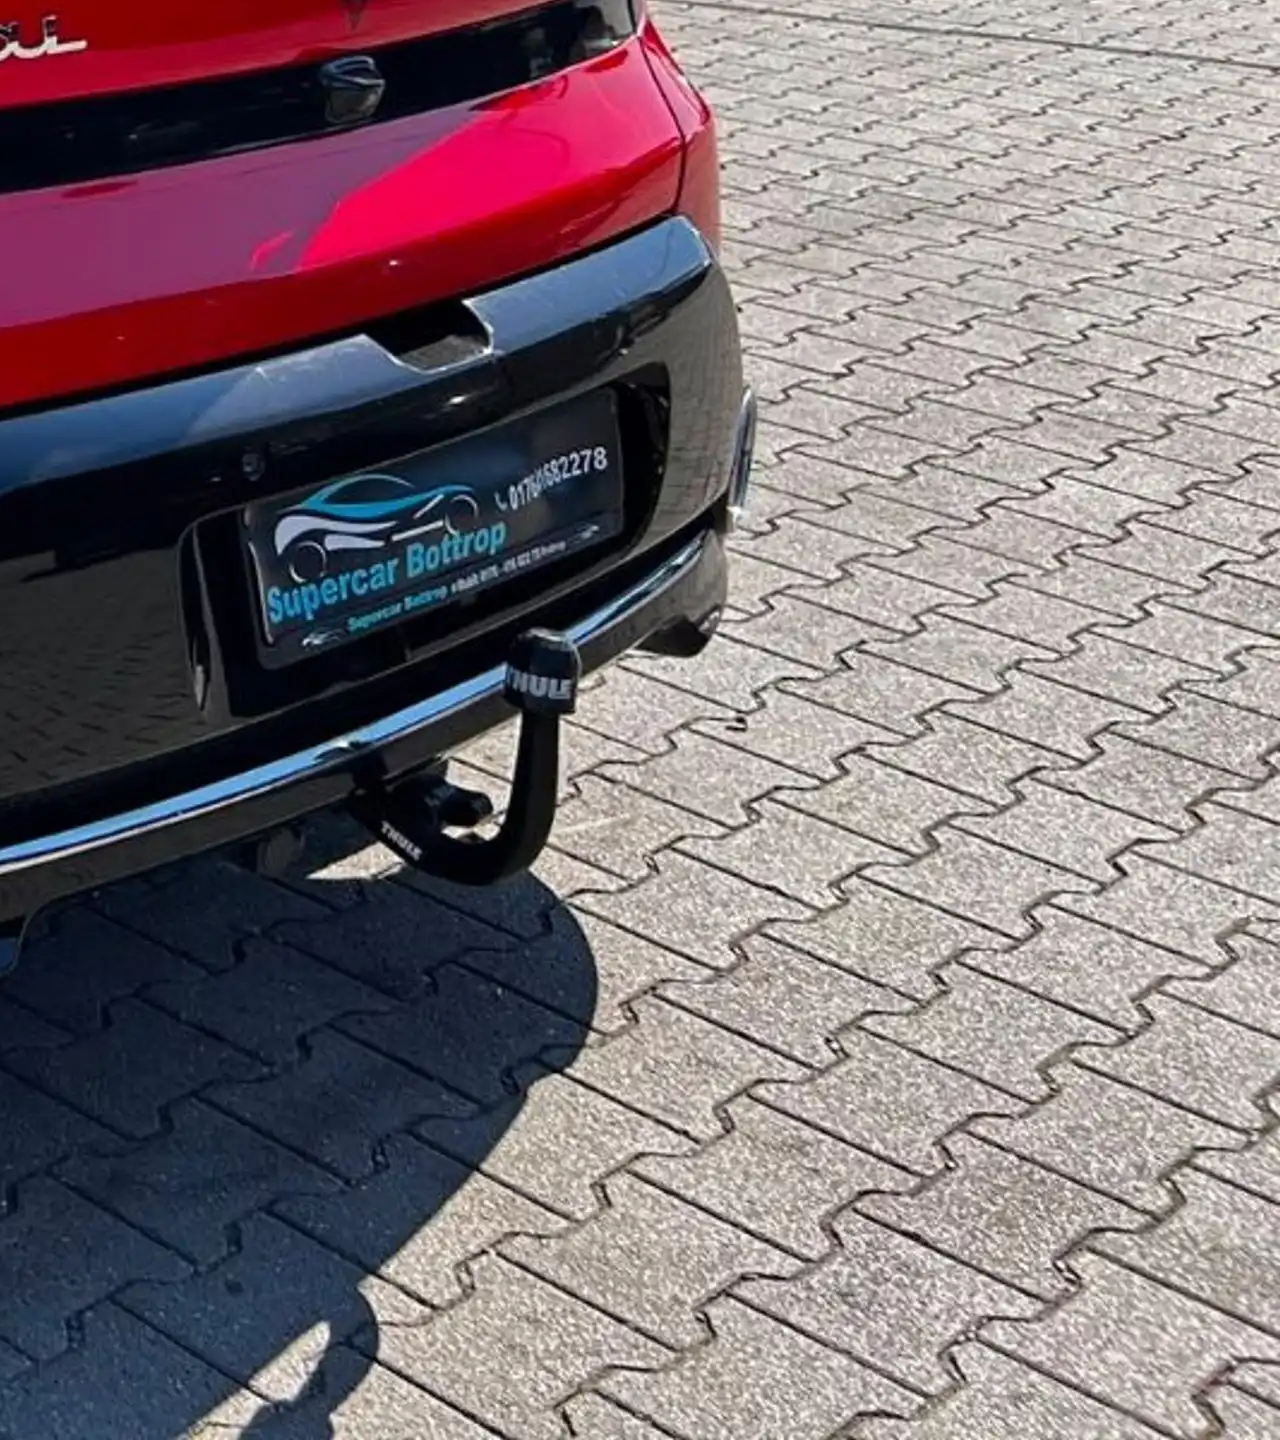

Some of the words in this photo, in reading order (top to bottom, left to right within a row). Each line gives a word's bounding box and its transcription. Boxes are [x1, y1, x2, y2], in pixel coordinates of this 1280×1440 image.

[267, 559, 399, 624] Supercar
[405, 521, 507, 578] Bottrop
[507, 664, 573, 701] THULE
